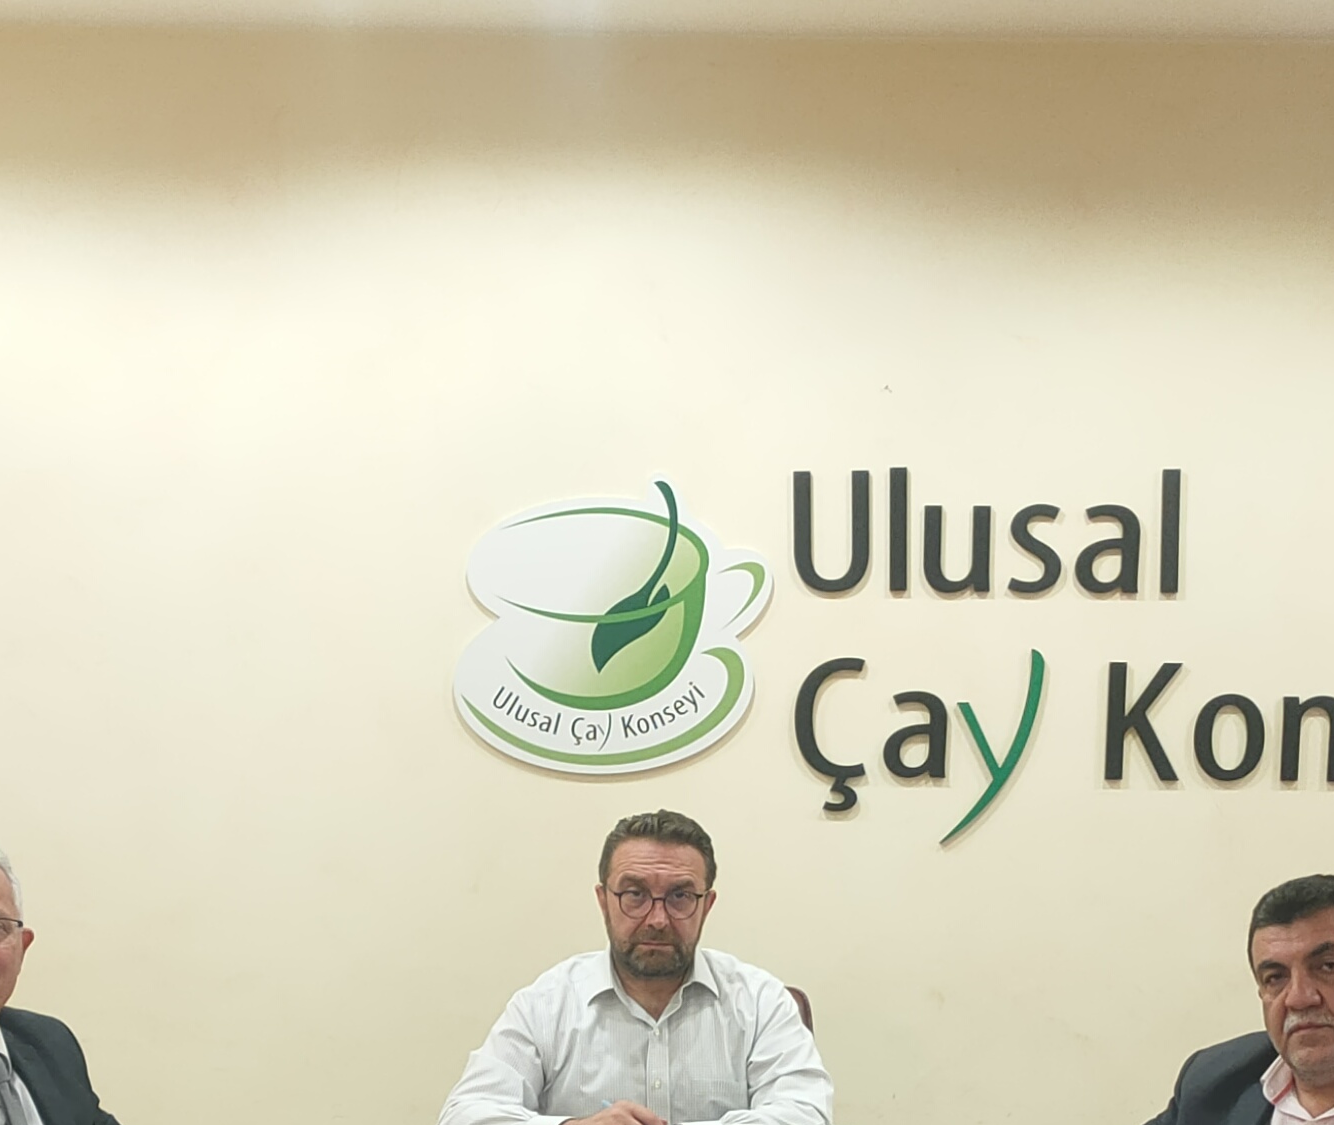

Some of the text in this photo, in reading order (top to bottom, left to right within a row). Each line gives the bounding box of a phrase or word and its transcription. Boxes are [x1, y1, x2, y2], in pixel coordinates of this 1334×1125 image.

[793, 467, 1182, 598] Ulusal
[492, 681, 706, 752] Ulusal Çay Konseyi
[794, 649, 1045, 846] Çay
